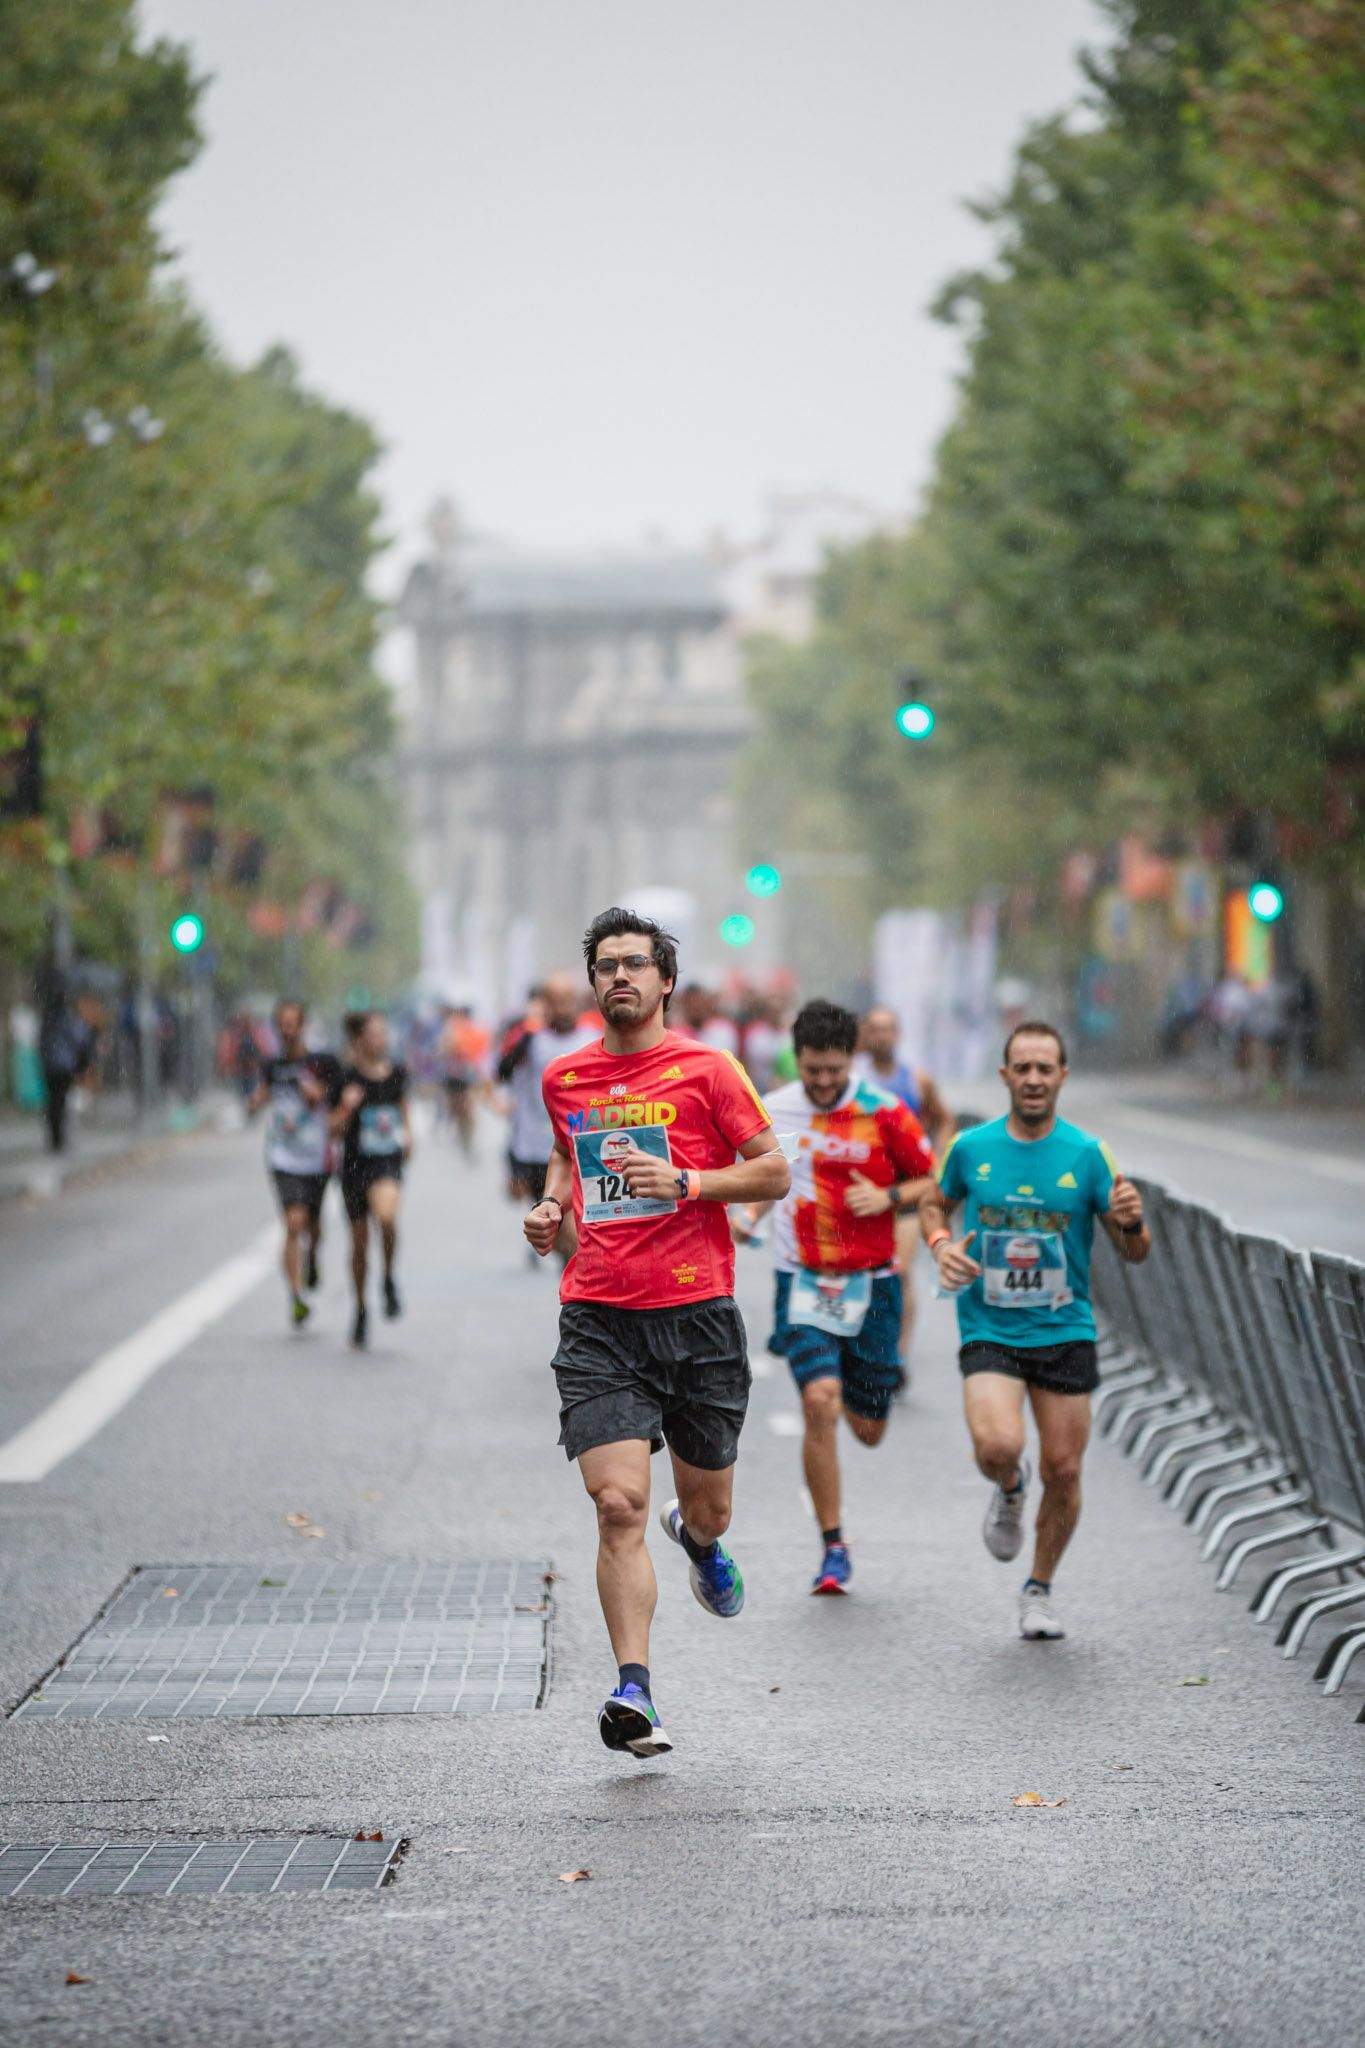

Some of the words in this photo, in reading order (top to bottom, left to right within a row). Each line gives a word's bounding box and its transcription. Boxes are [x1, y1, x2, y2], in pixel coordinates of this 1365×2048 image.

[609, 1083, 627, 1096] edp
[567, 1102, 677, 1136] MADRID
[1004, 1270, 1042, 1291] 444
